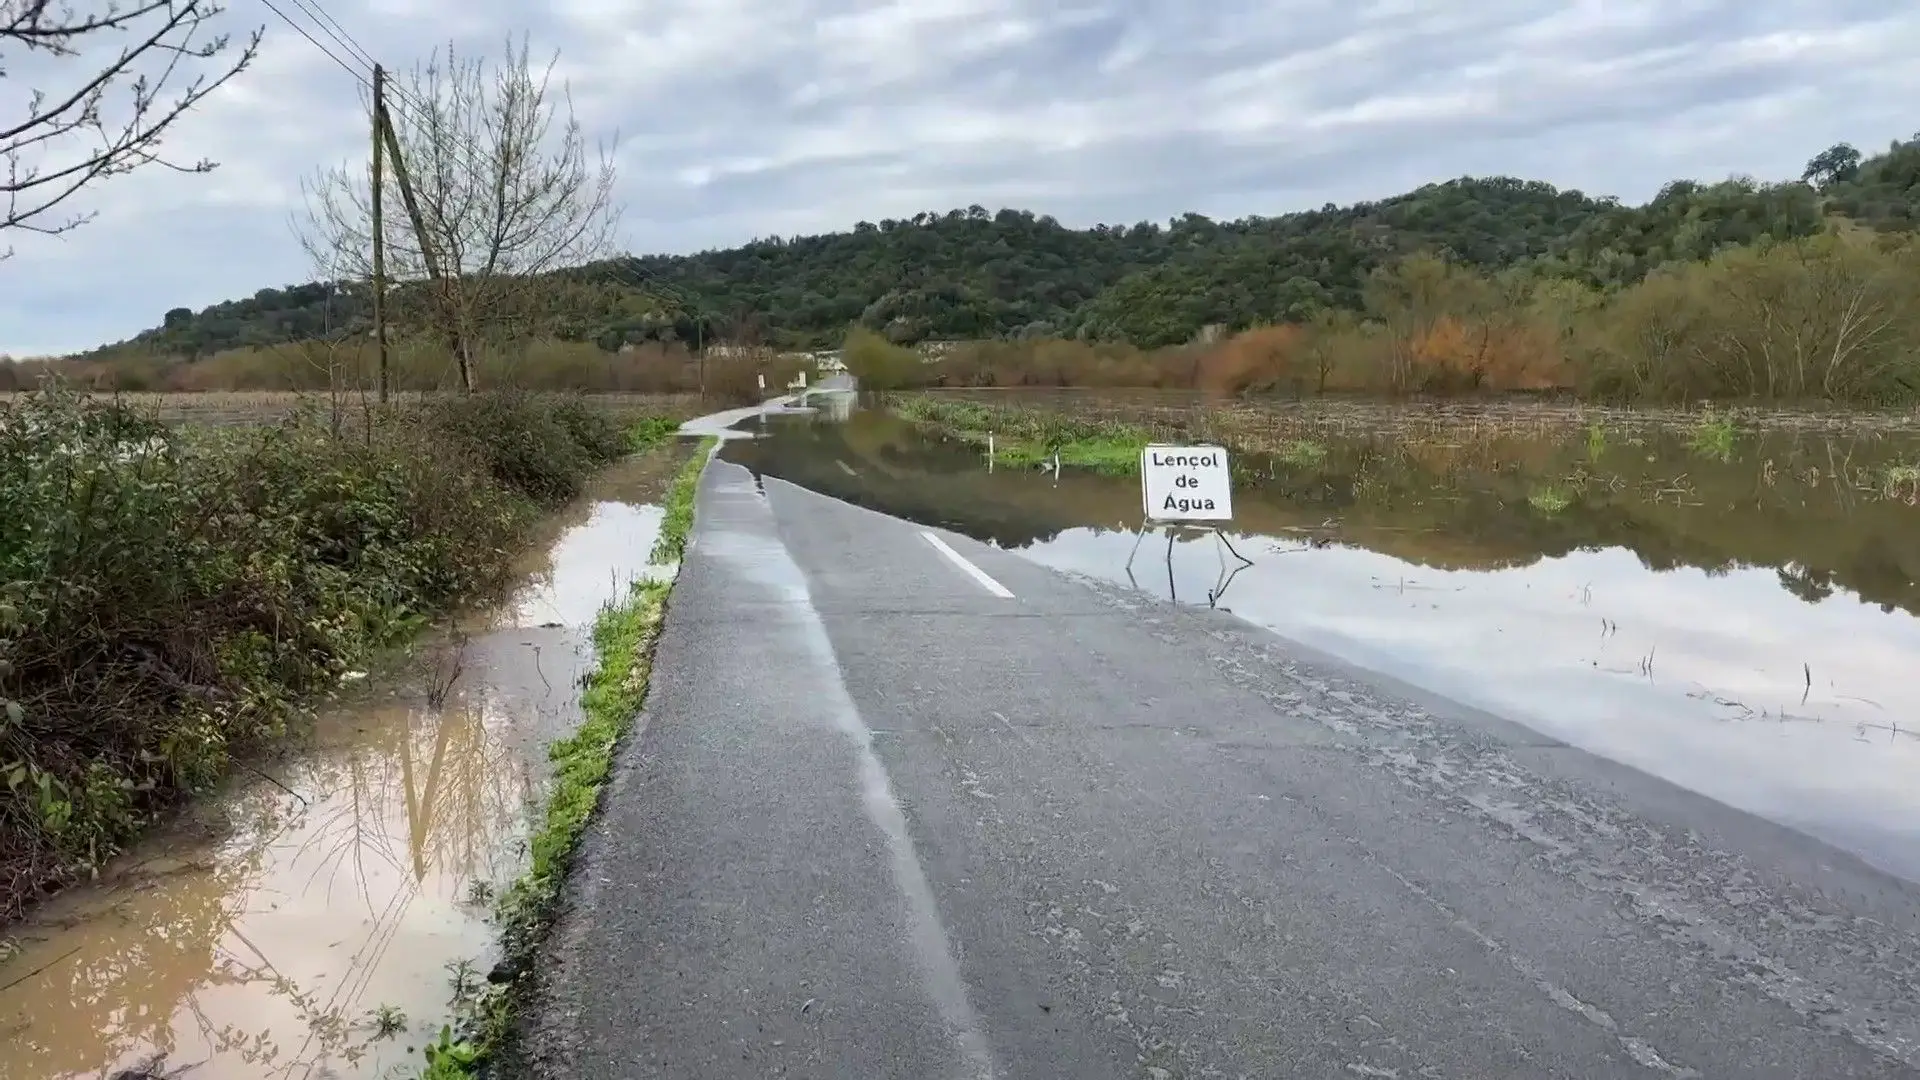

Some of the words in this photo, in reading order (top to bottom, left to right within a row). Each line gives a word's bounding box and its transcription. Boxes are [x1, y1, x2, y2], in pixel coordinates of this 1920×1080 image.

[1153, 452, 1218, 470] Lençol
[1175, 474, 1199, 488] de
[1163, 492, 1215, 512] Água
